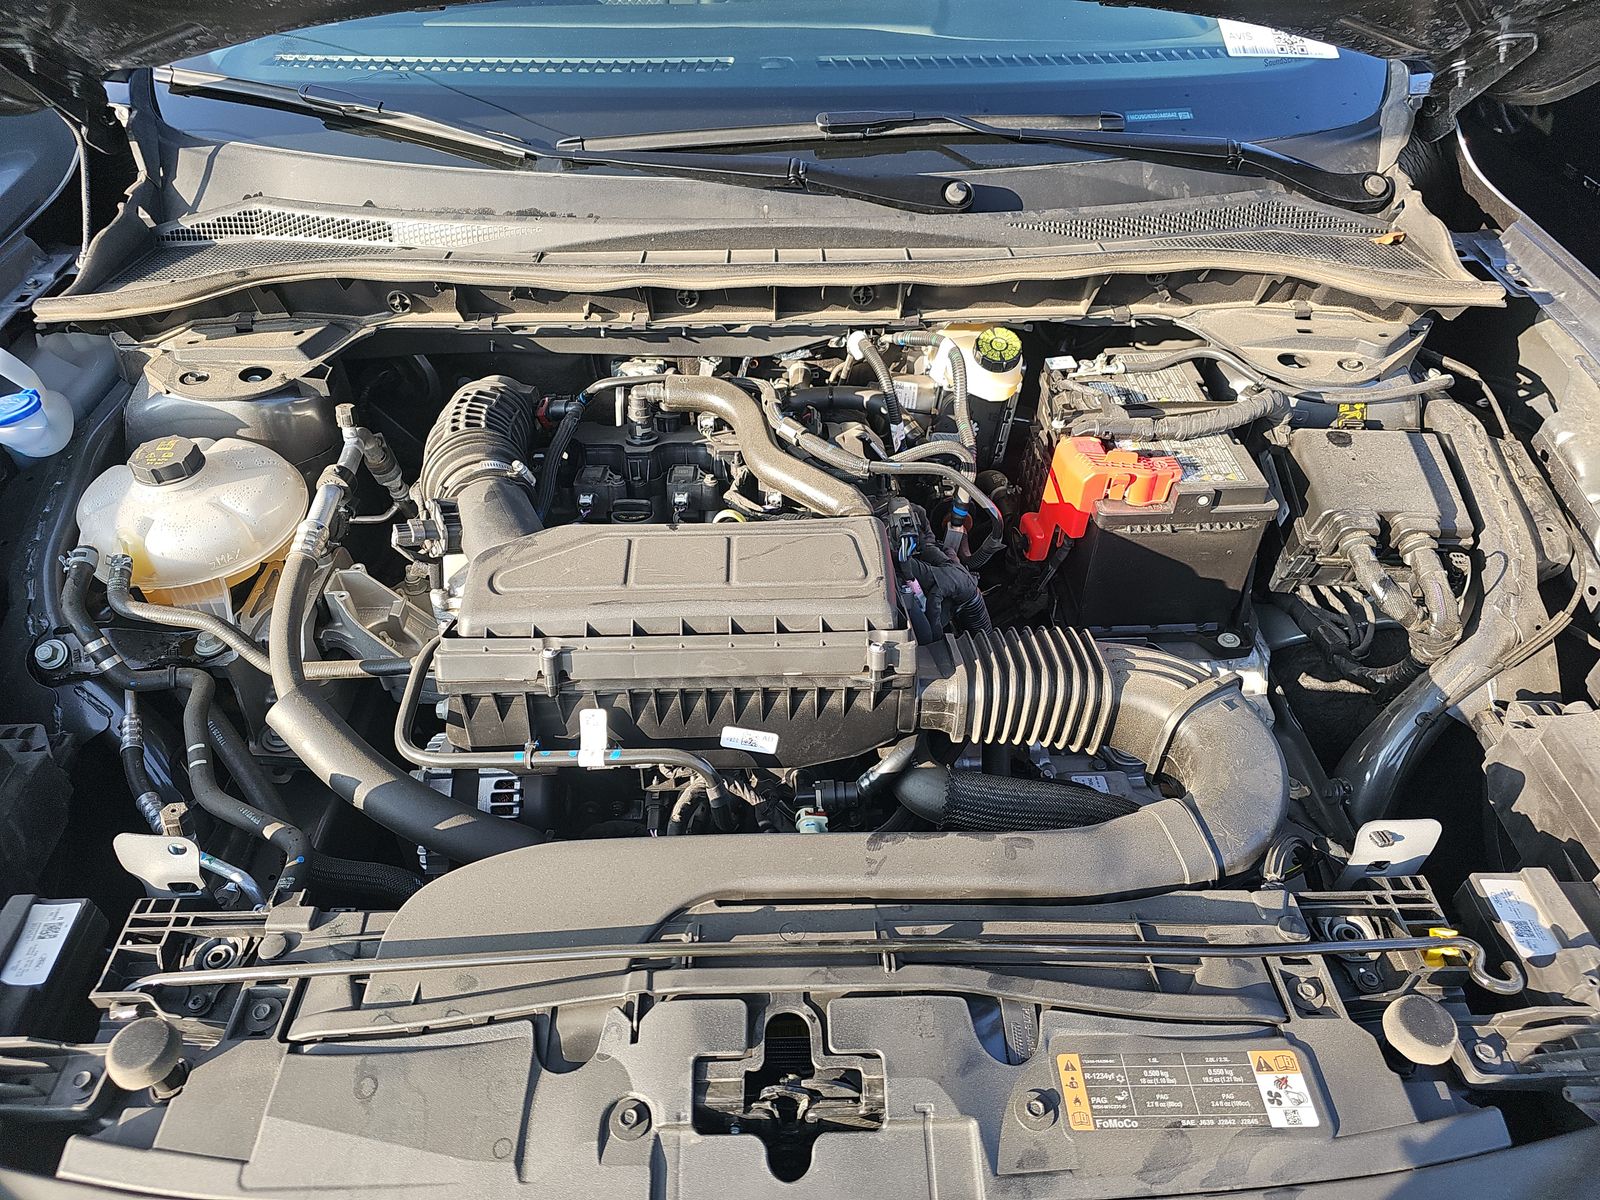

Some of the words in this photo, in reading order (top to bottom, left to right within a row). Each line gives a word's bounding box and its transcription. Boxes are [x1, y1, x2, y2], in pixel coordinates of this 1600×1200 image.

[1084, 1072, 1115, 1081] R-1234yf
[1090, 1096, 1108, 1104] PAG
[1096, 1119, 1139, 1129] FoMoCo
